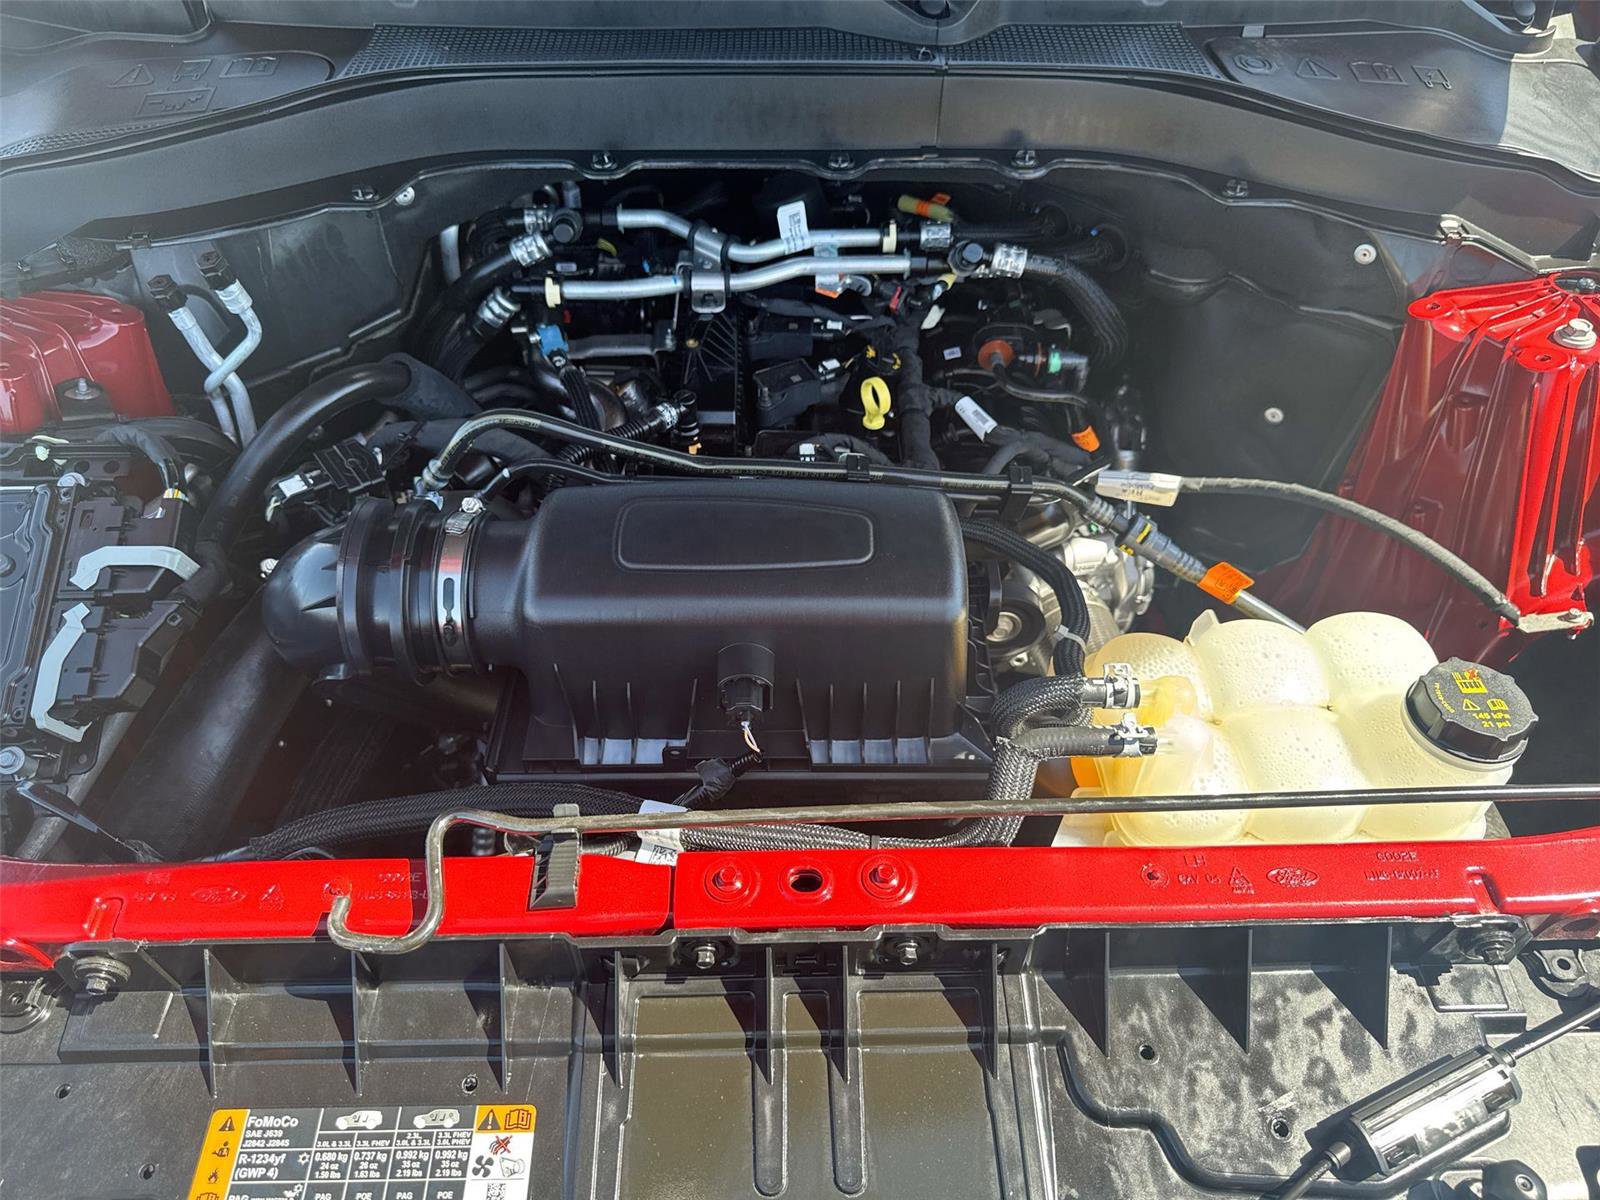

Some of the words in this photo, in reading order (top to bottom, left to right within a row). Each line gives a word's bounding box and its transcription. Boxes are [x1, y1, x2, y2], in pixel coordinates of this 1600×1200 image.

[247, 1115, 299, 1128] FoMoCo
[245, 1130, 263, 1138] SAE
[238, 1153, 286, 1166] R-1234yf
[338, 1152, 348, 1163] kg
[354, 1152, 376, 1160] 0.737
[376, 1152, 388, 1162] kg
[396, 1150, 418, 1160] 0.992
[418, 1150, 430, 1162] kg
[435, 1150, 456, 1159] 0.992
[458, 1150, 468, 1161] kg
[320, 1162, 330, 1170] 24
[402, 1160, 411, 1168] 35
[440, 1160, 450, 1168] 35
[234, 1168, 267, 1180] (GWP
[268, 1168, 278, 1180] 4)
[369, 1170, 380, 1178] lbs
[396, 1192, 414, 1200] PAG
[436, 1192, 454, 1200] POE
